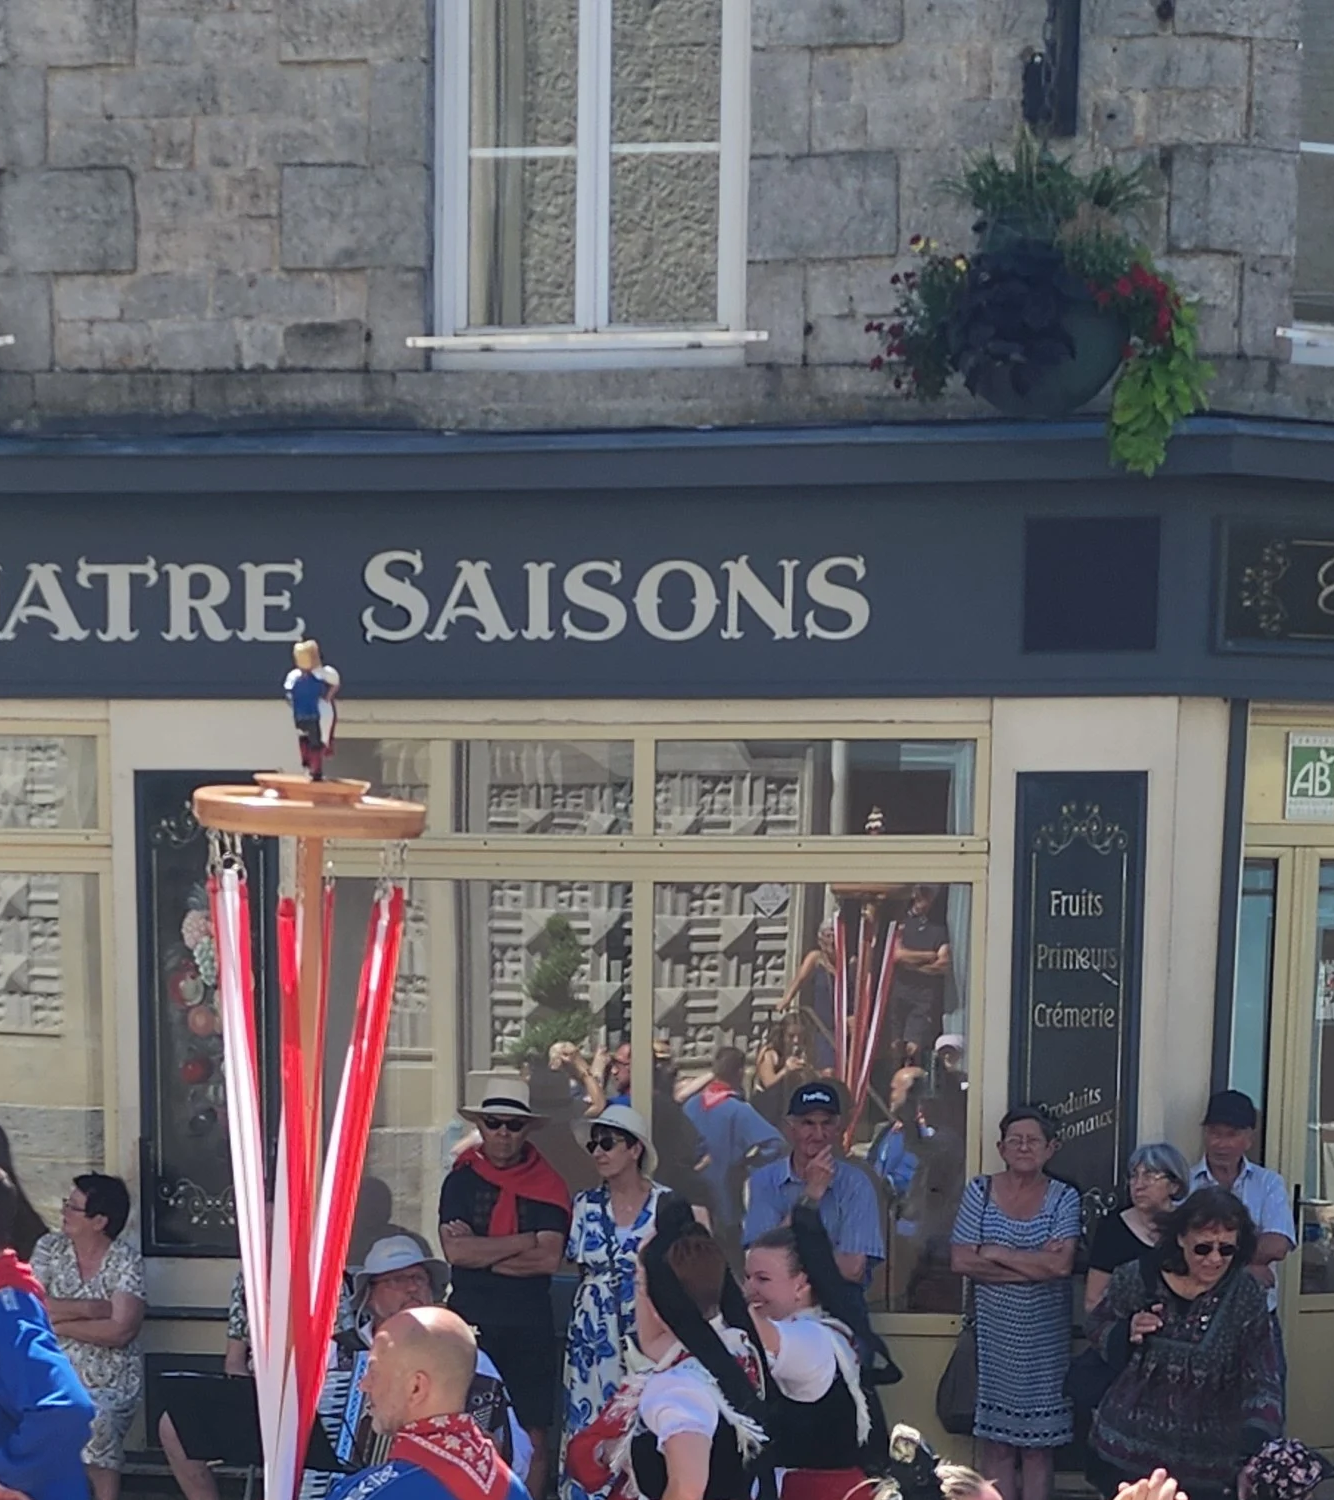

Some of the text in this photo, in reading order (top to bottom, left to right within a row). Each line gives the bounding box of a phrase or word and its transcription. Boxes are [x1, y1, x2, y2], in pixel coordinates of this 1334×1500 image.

[362, 550, 870, 642] SAISONS
[1292, 761, 1331, 796] AB
[1050, 888, 1103, 916] Fruits
[1036, 942, 1118, 970] Primeurs
[1034, 1001, 1116, 1029] Crémerie
